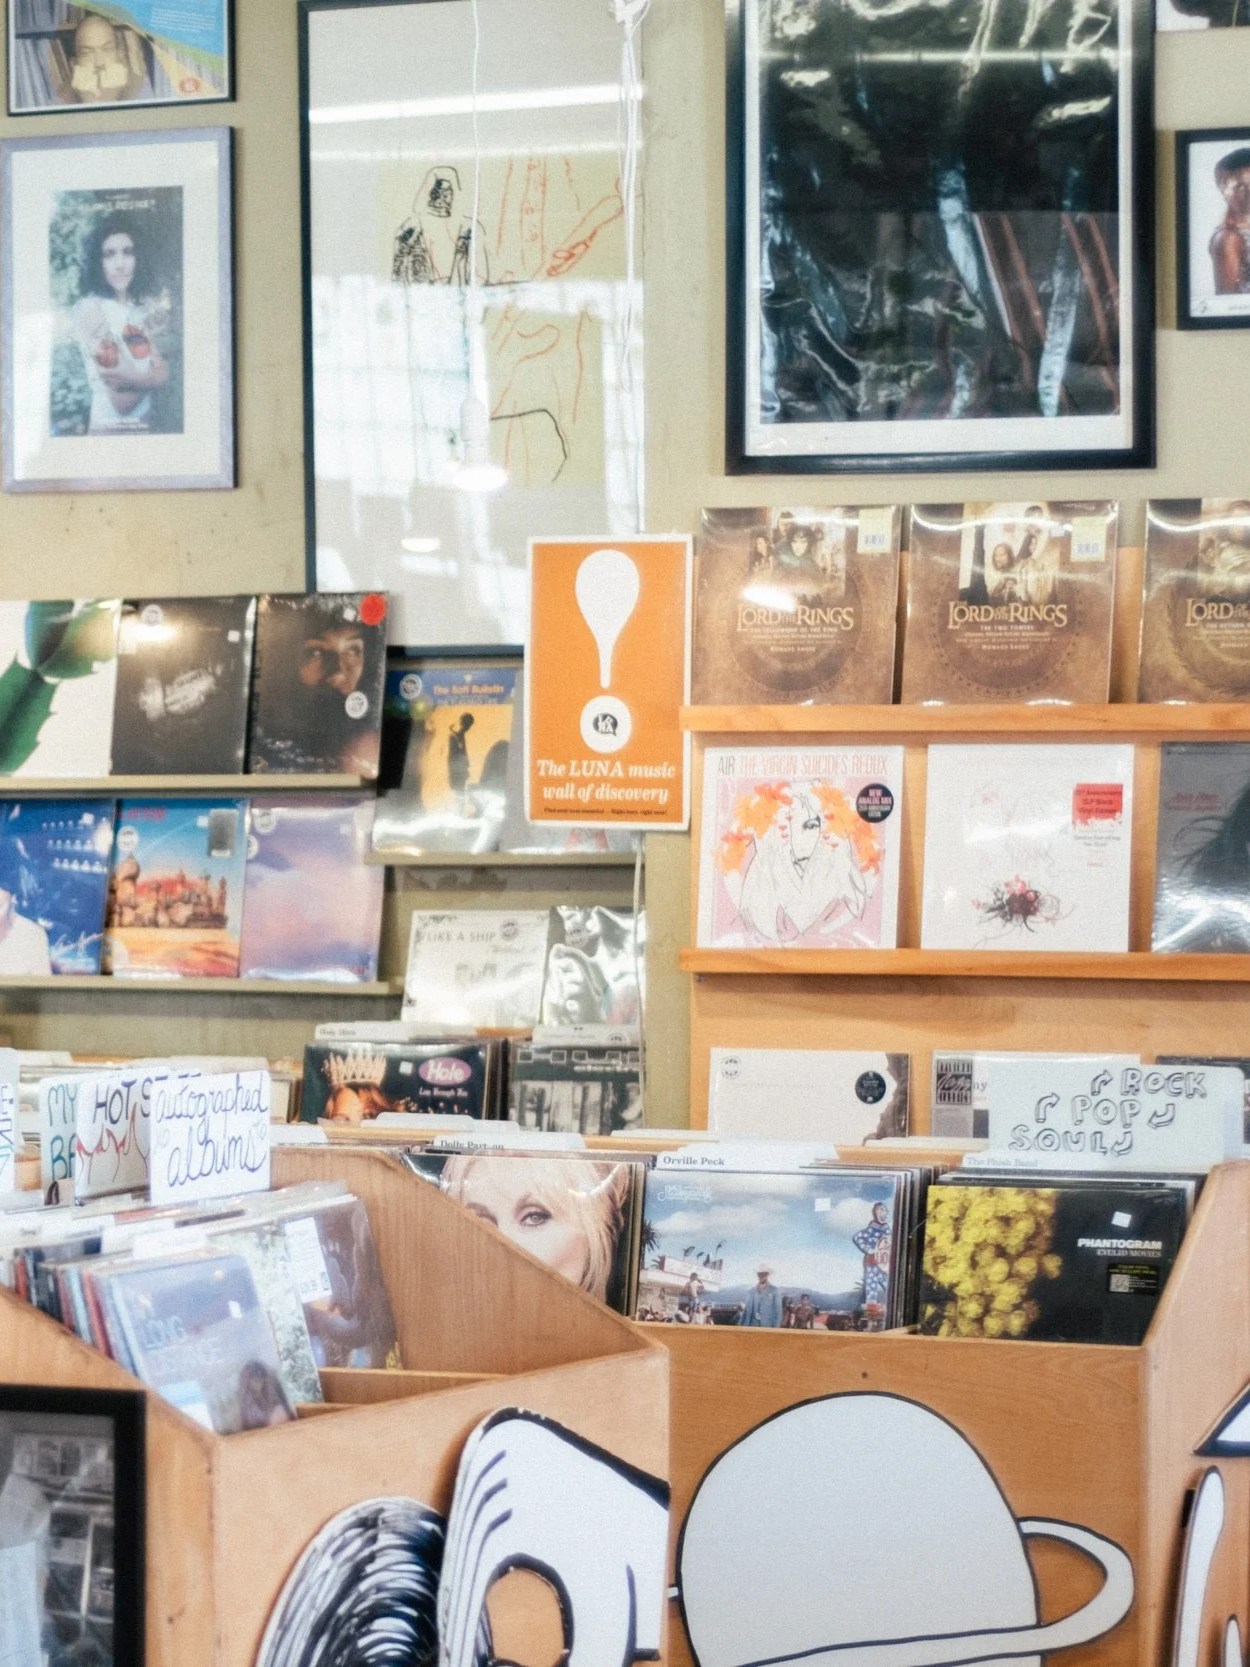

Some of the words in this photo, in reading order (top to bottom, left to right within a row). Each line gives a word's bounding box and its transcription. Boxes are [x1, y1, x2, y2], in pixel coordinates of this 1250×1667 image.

[796, 605, 855, 631] RINGS
[947, 601, 994, 630] LORD
[1008, 602, 1068, 628] RINGS
[1185, 598, 1234, 627] LORD
[537, 759, 566, 777] The
[568, 759, 624, 778] LUNA
[628, 761, 676, 779] music
[717, 756, 736, 775] AIR
[739, 754, 757, 774] THE
[762, 754, 798, 775] VIRGIN
[802, 754, 848, 775] SUICIDES
[543, 782, 575, 799] wall
[578, 783, 595, 803] of
[595, 783, 670, 805] discovery
[428, 930, 451, 943] LIKE
[457, 930, 466, 943] A
[469, 930, 497, 943] SHIP
[426, 1059, 465, 1082] Hole
[1120, 1067, 1208, 1099] ROCK
[93, 1078, 138, 1125] HOT
[1071, 1098, 1142, 1128] POP
[1008, 1123, 1108, 1156] SOUL
[168, 1126, 267, 1188] albums
[662, 1155, 699, 1166] Orville
[701, 1156, 726, 1166] Peck
[1076, 1237, 1163, 1250] PHANTOGRAM
[1096, 1248, 1129, 1257] EYELID
[1129, 1249, 1163, 1258] MOVIES
